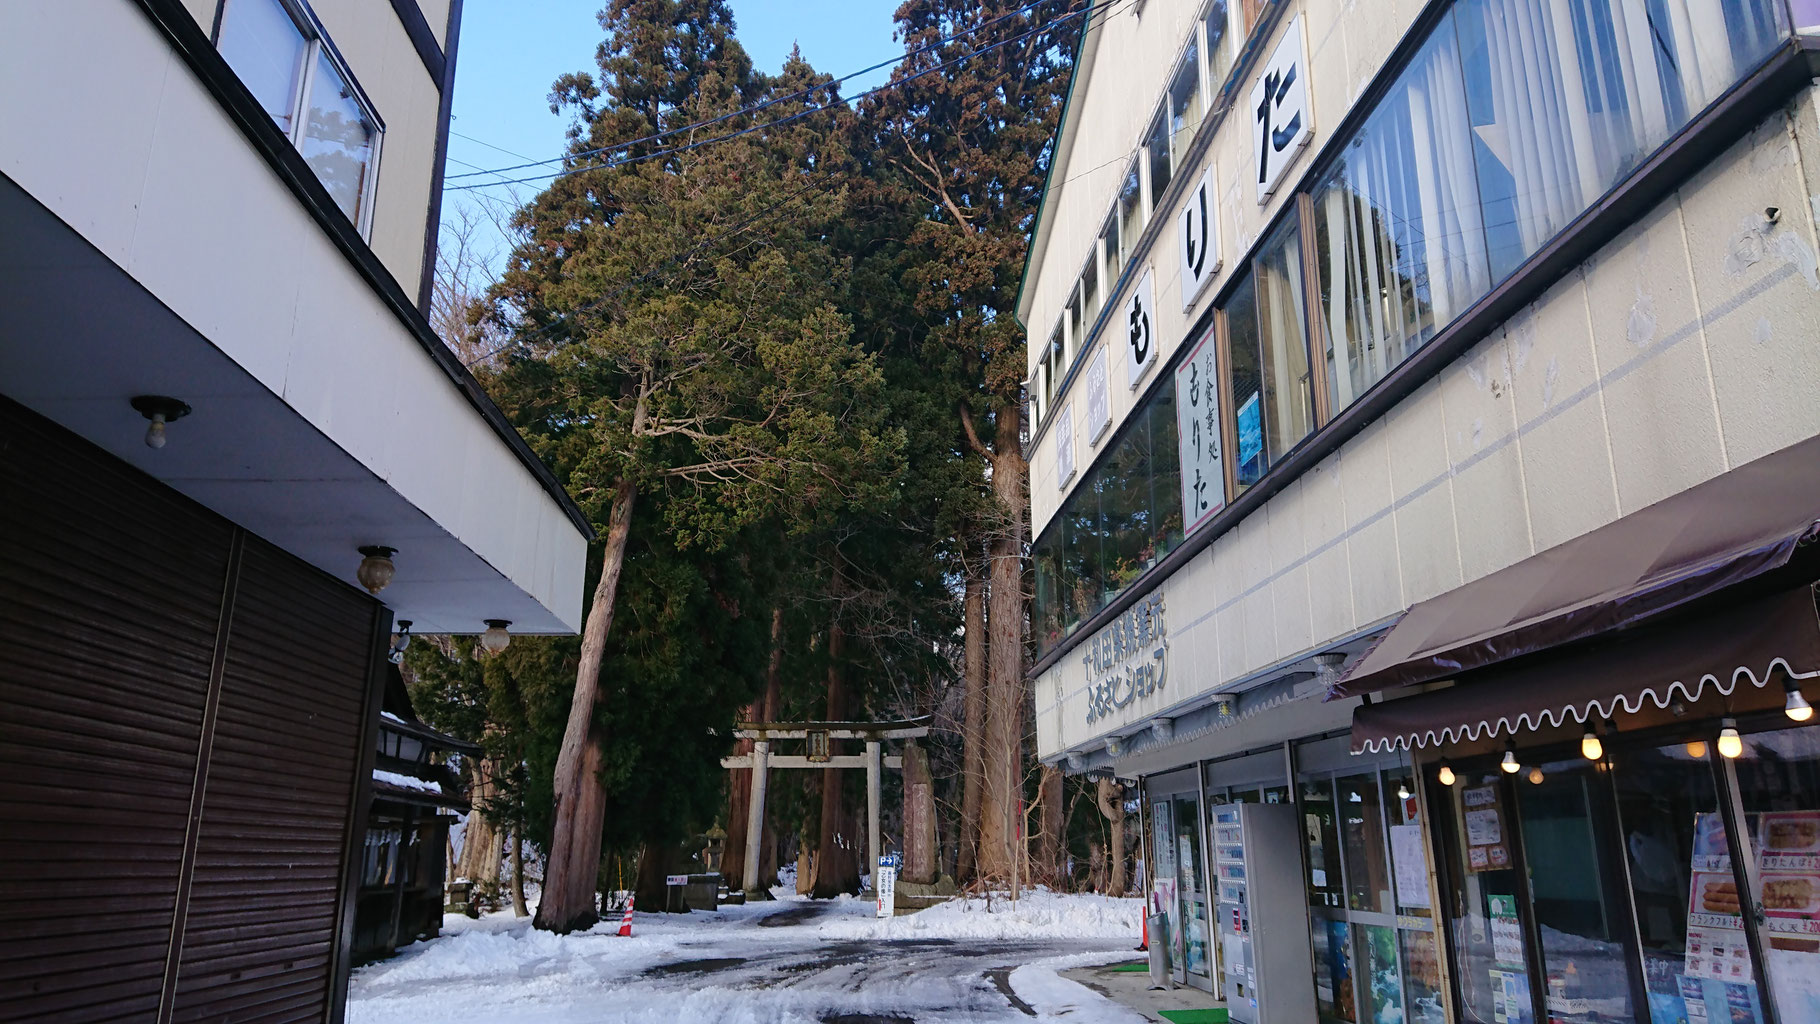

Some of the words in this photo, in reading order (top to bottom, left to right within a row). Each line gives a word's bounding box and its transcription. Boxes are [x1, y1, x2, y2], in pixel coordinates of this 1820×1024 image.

[1130, 61, 1301, 364] もりた
[1190, 362, 1208, 518] もりた
[880, 857, 886, 865] P
